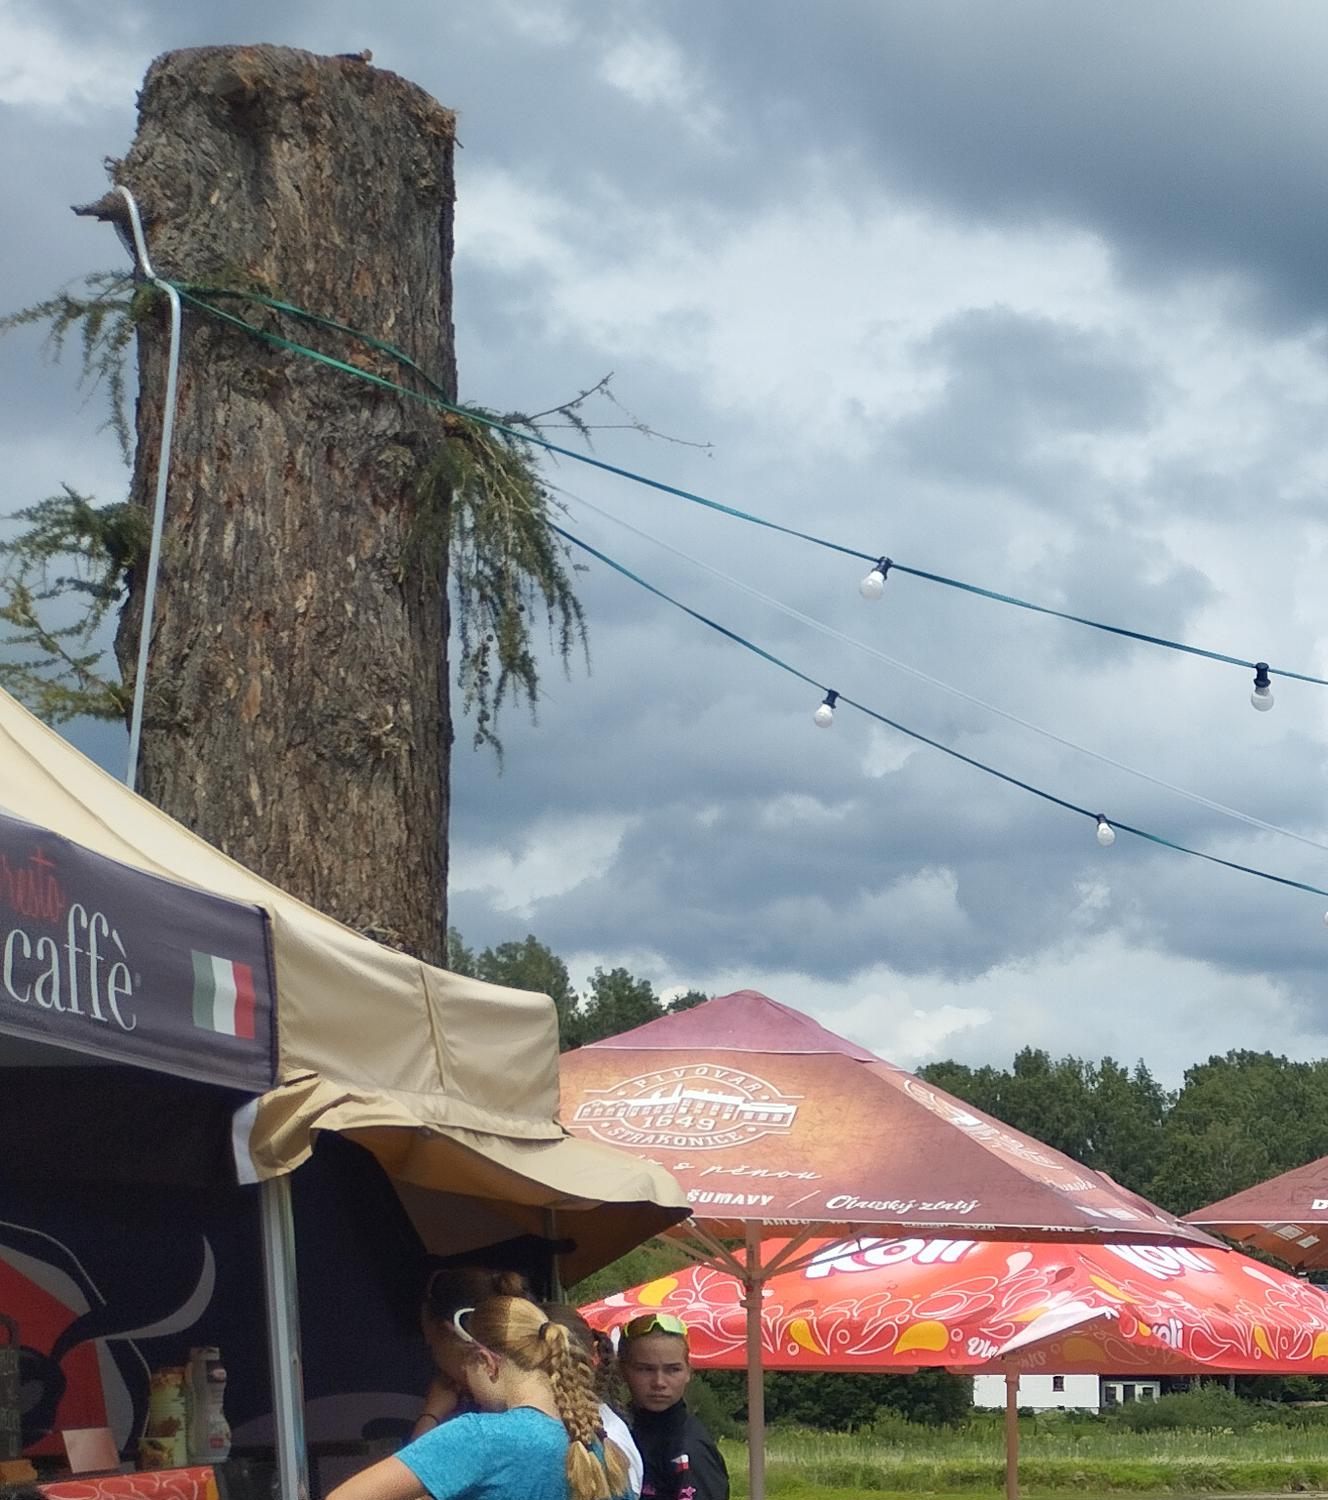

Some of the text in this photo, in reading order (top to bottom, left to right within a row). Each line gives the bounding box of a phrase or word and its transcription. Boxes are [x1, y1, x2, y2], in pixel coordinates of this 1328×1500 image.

[4, 903, 137, 1031] caffè
[634, 1066, 763, 1093] PIVOVAR
[641, 1115, 716, 1131] 1649
[607, 1126, 744, 1147] STRAKONICE
[700, 1164, 823, 1180] pěnou
